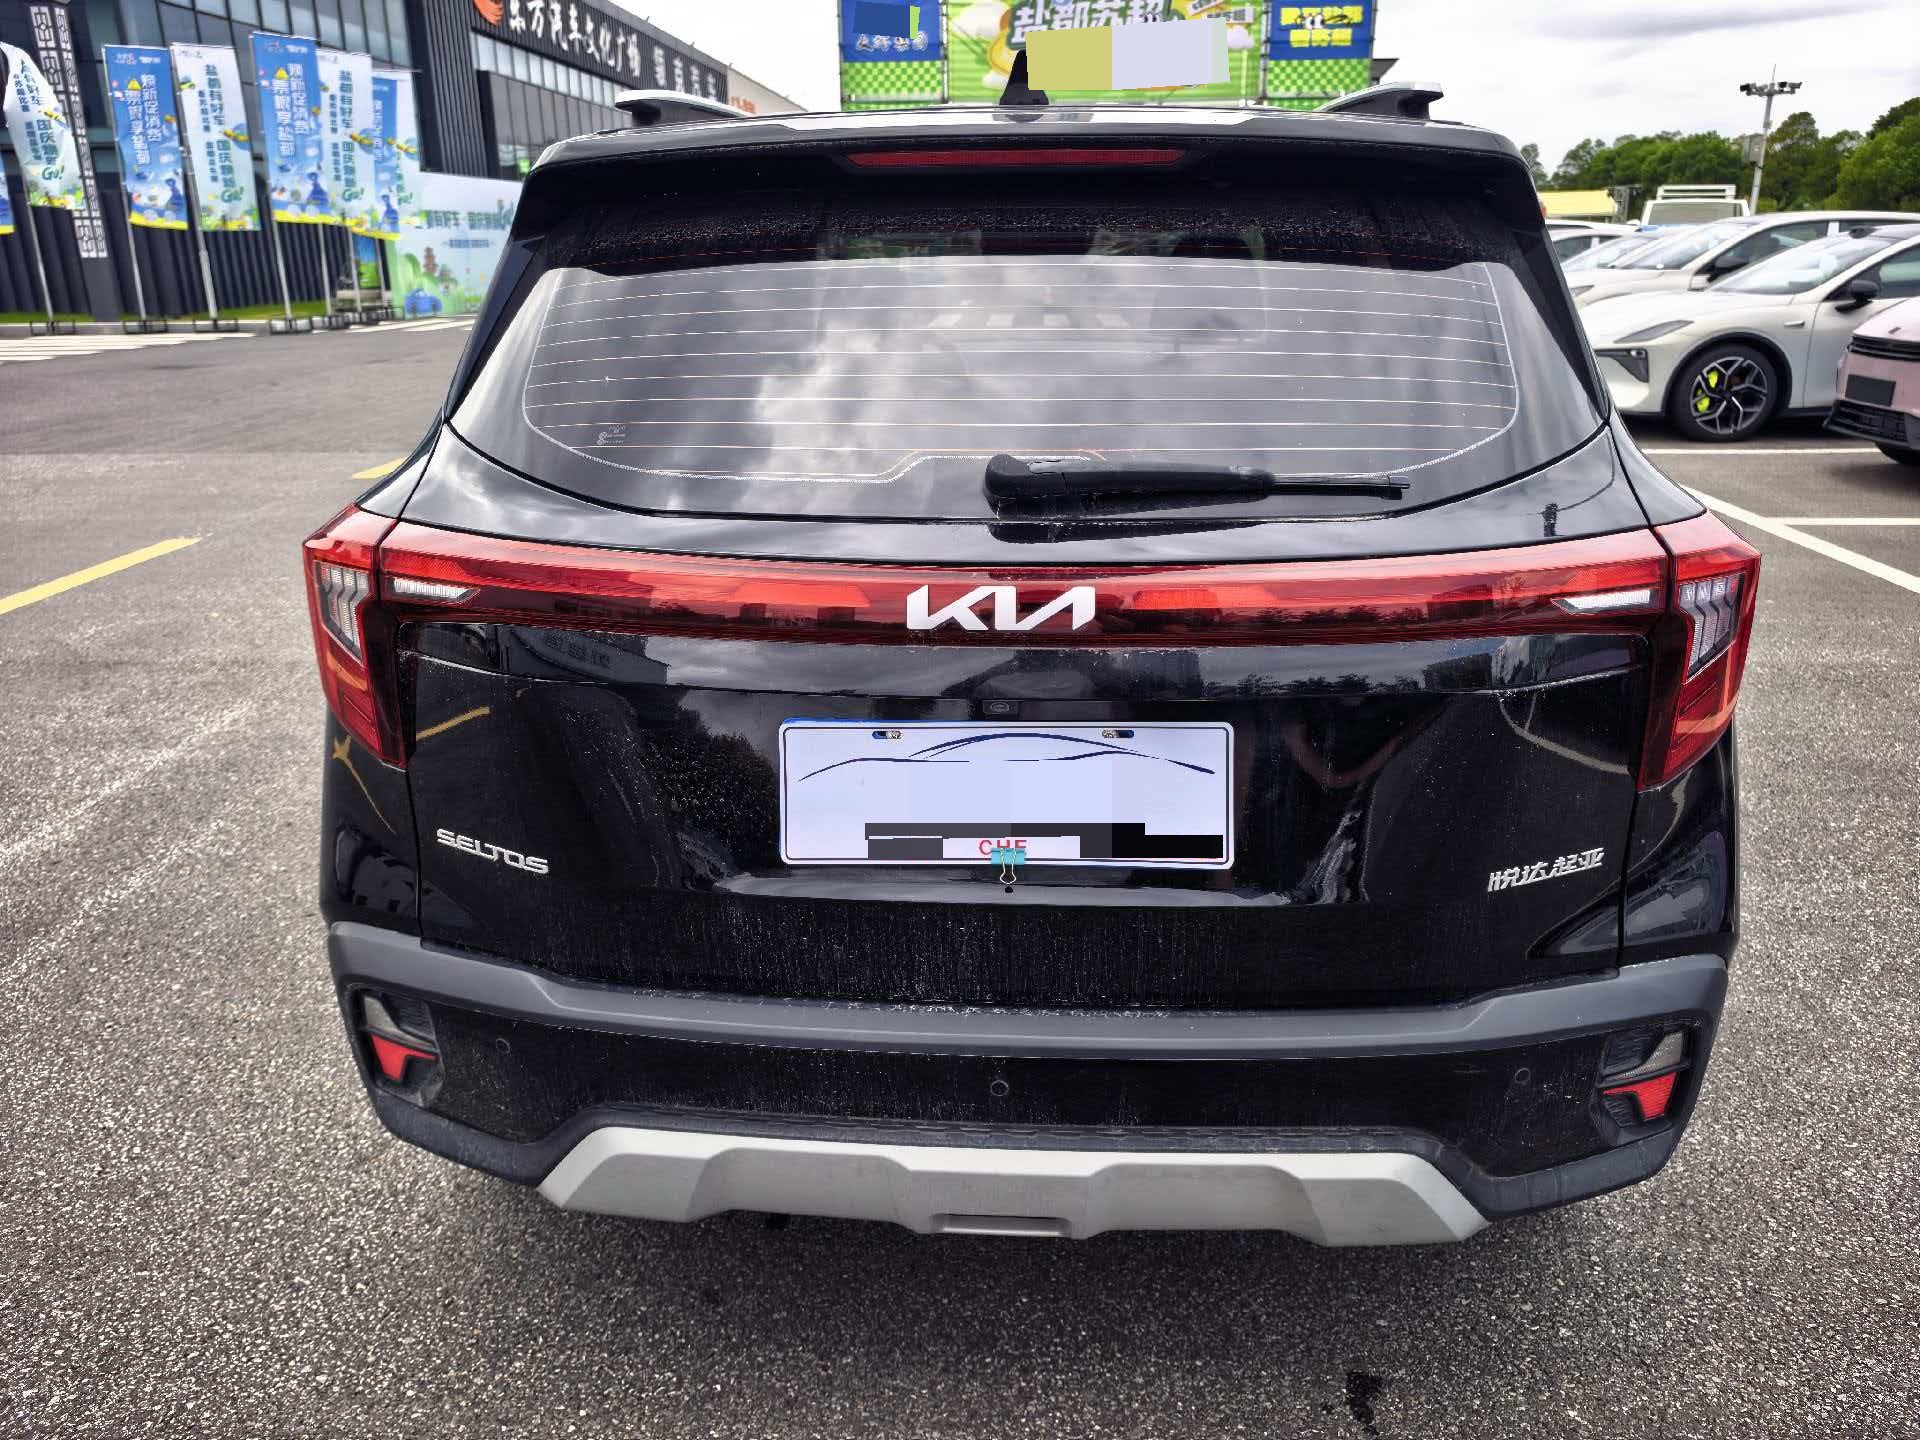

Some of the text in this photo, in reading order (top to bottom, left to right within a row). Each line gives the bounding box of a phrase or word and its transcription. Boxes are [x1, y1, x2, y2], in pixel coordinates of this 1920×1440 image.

[907, 585, 1096, 631] KIA
[437, 829, 549, 874] SELTOS
[1487, 847, 1605, 892] 悦达起亚
